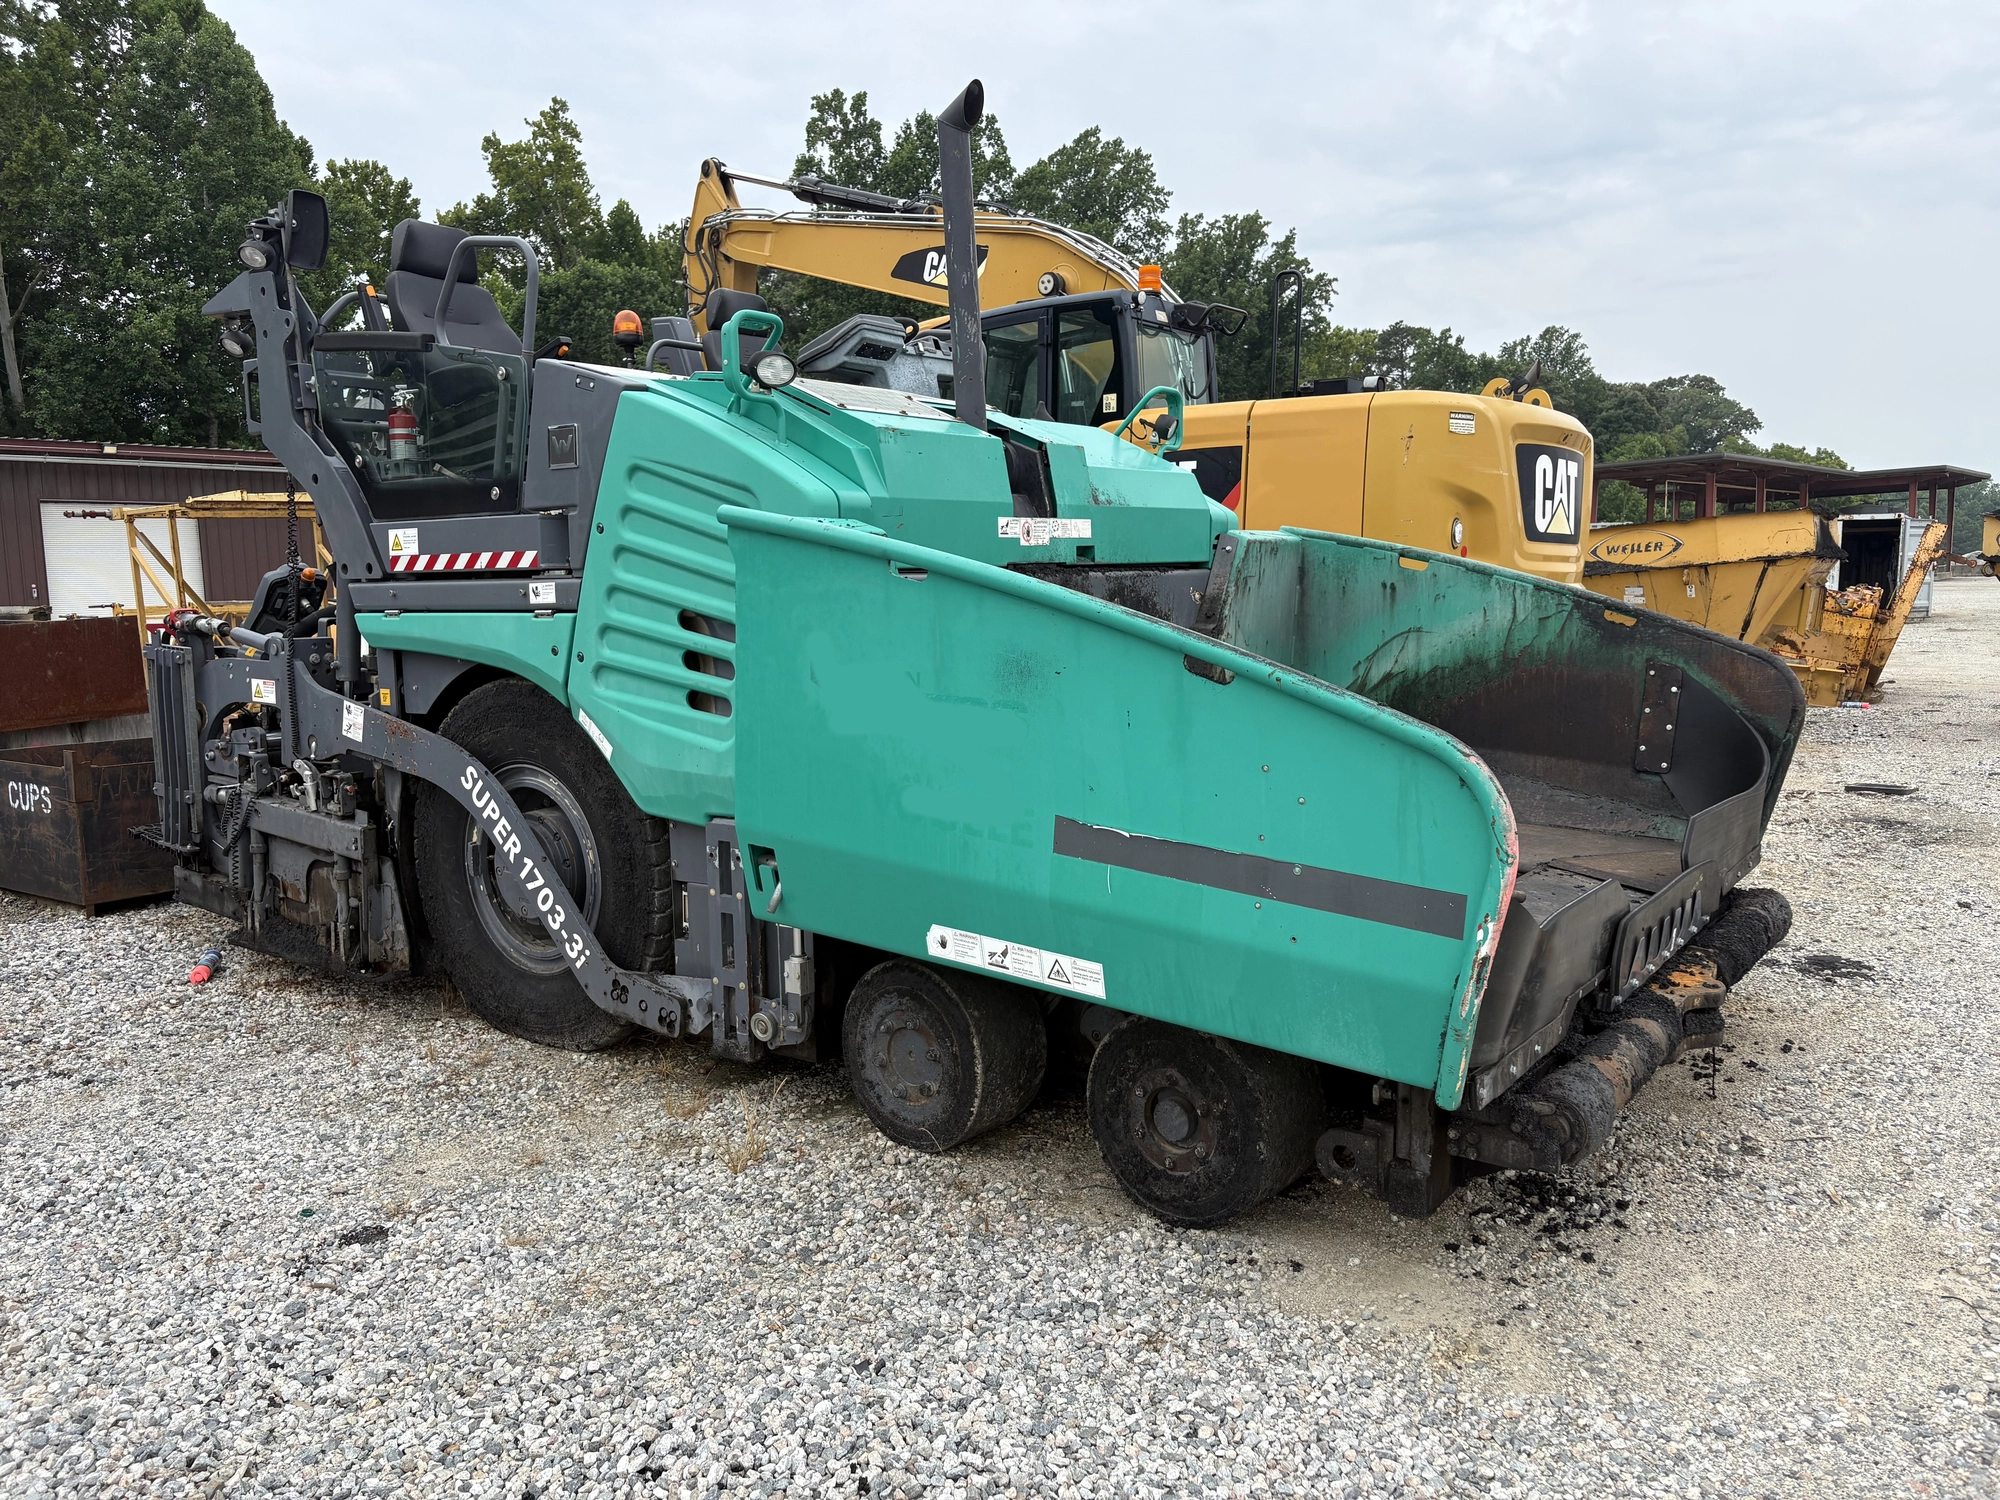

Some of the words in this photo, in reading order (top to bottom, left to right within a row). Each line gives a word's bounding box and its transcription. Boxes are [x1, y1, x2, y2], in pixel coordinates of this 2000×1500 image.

[1535, 454, 1578, 535] CAT
[1606, 541, 1664, 556] WEILER
[8, 780, 52, 814] CUPS
[460, 765, 522, 864] SUPER
[519, 857, 590, 969] 1703-3i
